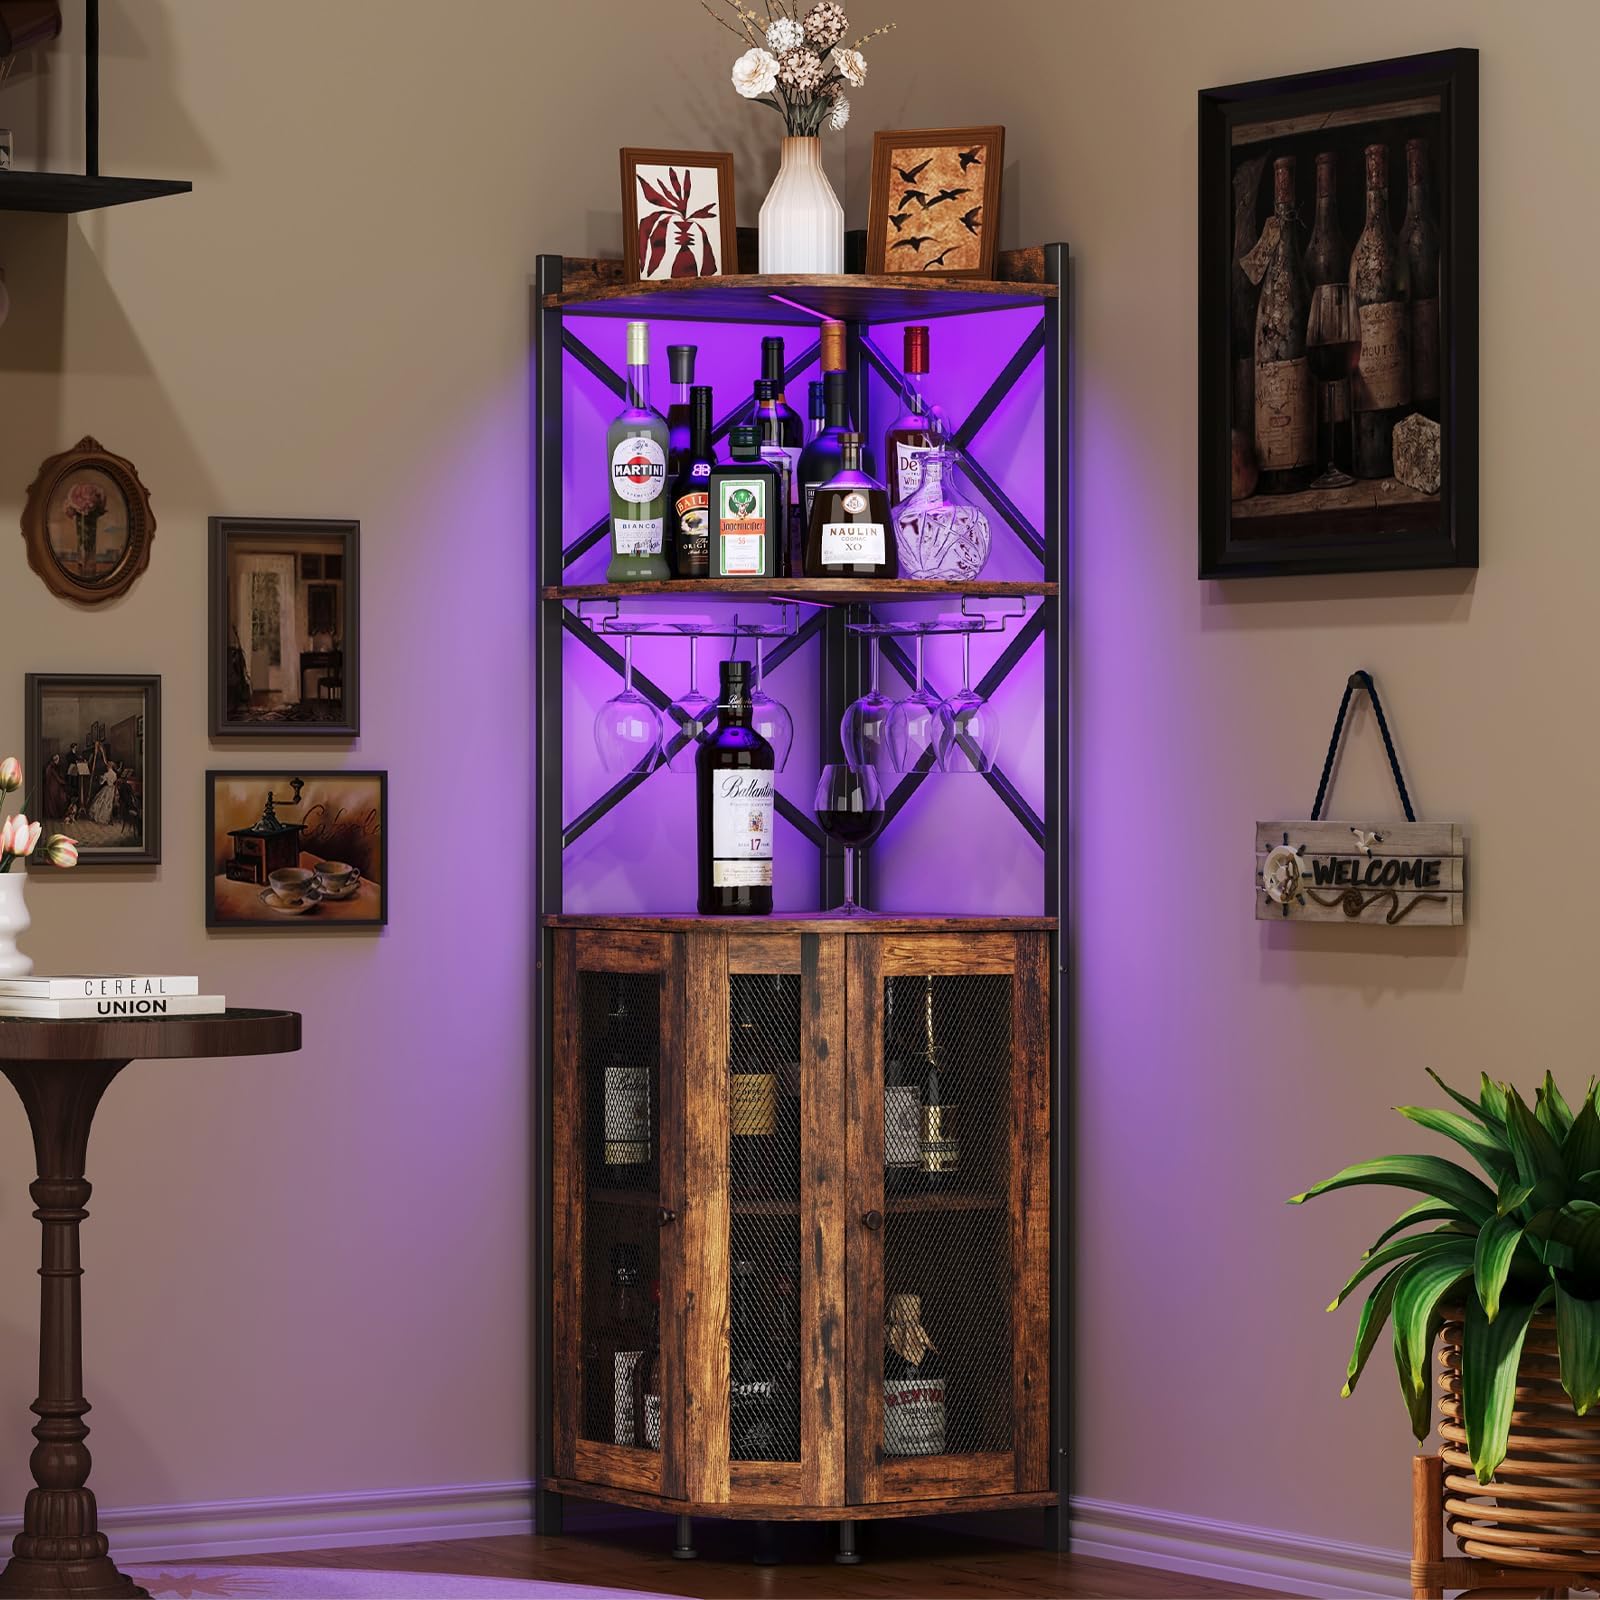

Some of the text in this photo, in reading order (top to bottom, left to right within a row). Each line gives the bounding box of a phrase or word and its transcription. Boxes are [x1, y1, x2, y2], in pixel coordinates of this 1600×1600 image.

[615, 464, 663, 476] MARTINI
[900, 456, 920, 471] De
[677, 495, 708, 511] BAIL
[830, 527, 877, 536] NAULIN
[845, 543, 863, 551] XO
[750, 838, 762, 851] 17
[1312, 857, 1442, 888] WELCOME
[84, 978, 166, 996] CEREAL
[97, 999, 167, 1015] UNION
